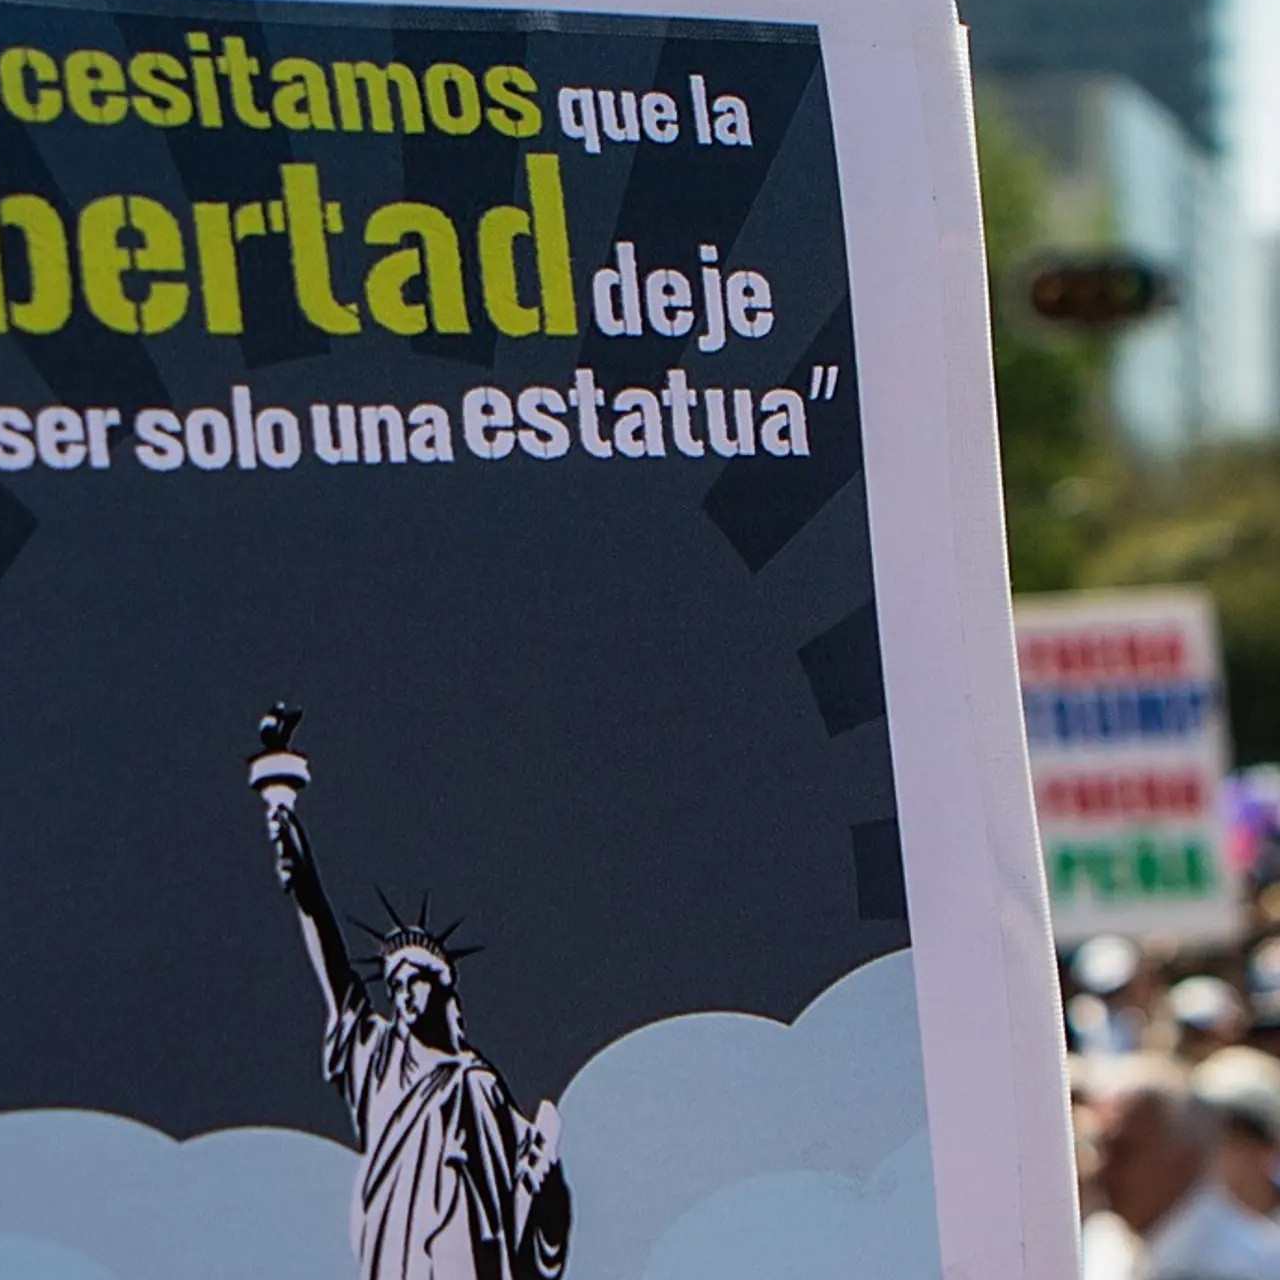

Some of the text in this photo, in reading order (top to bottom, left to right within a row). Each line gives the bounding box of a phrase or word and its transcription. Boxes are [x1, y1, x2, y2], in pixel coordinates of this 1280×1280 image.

[557, 86, 680, 154] que
[687, 73, 754, 147] la
[592, 241, 775, 353] deje
[133, 384, 304, 472] solo
[308, 403, 455, 465] una
